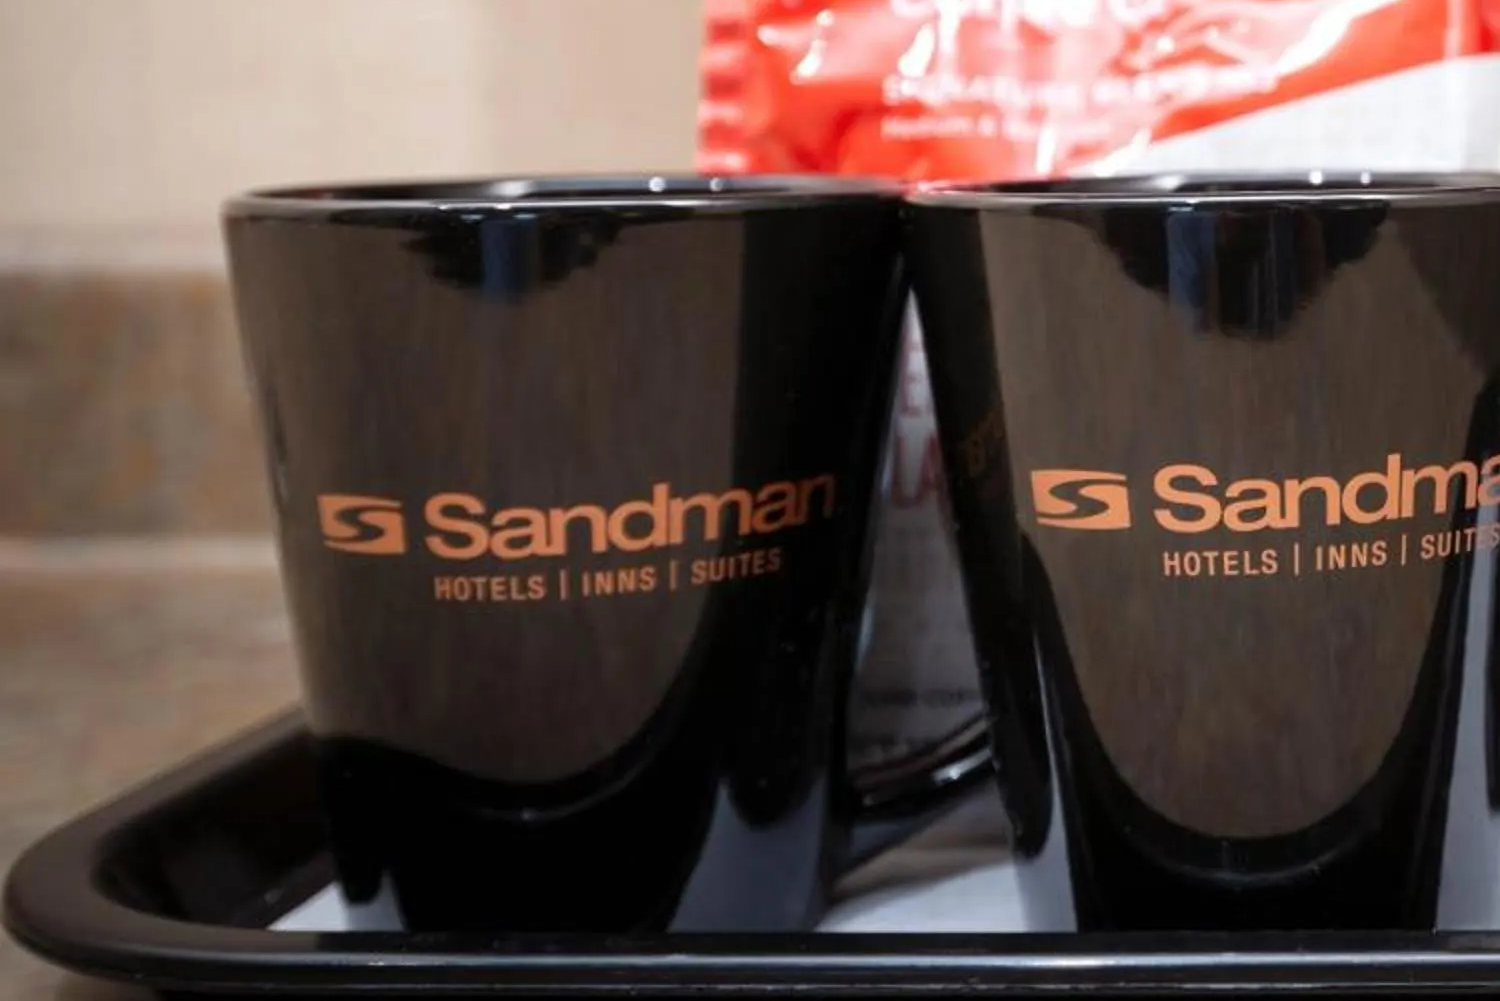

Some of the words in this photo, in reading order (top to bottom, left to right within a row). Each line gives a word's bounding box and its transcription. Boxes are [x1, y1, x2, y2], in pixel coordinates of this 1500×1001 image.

[423, 473, 836, 561] Sandman
[433, 575, 547, 601] HOTELS
[580, 565, 656, 597] INNS
[690, 547, 783, 586] SUITES
[1163, 549, 1278, 577] HOTELS
[1315, 540, 1387, 572] INNS
